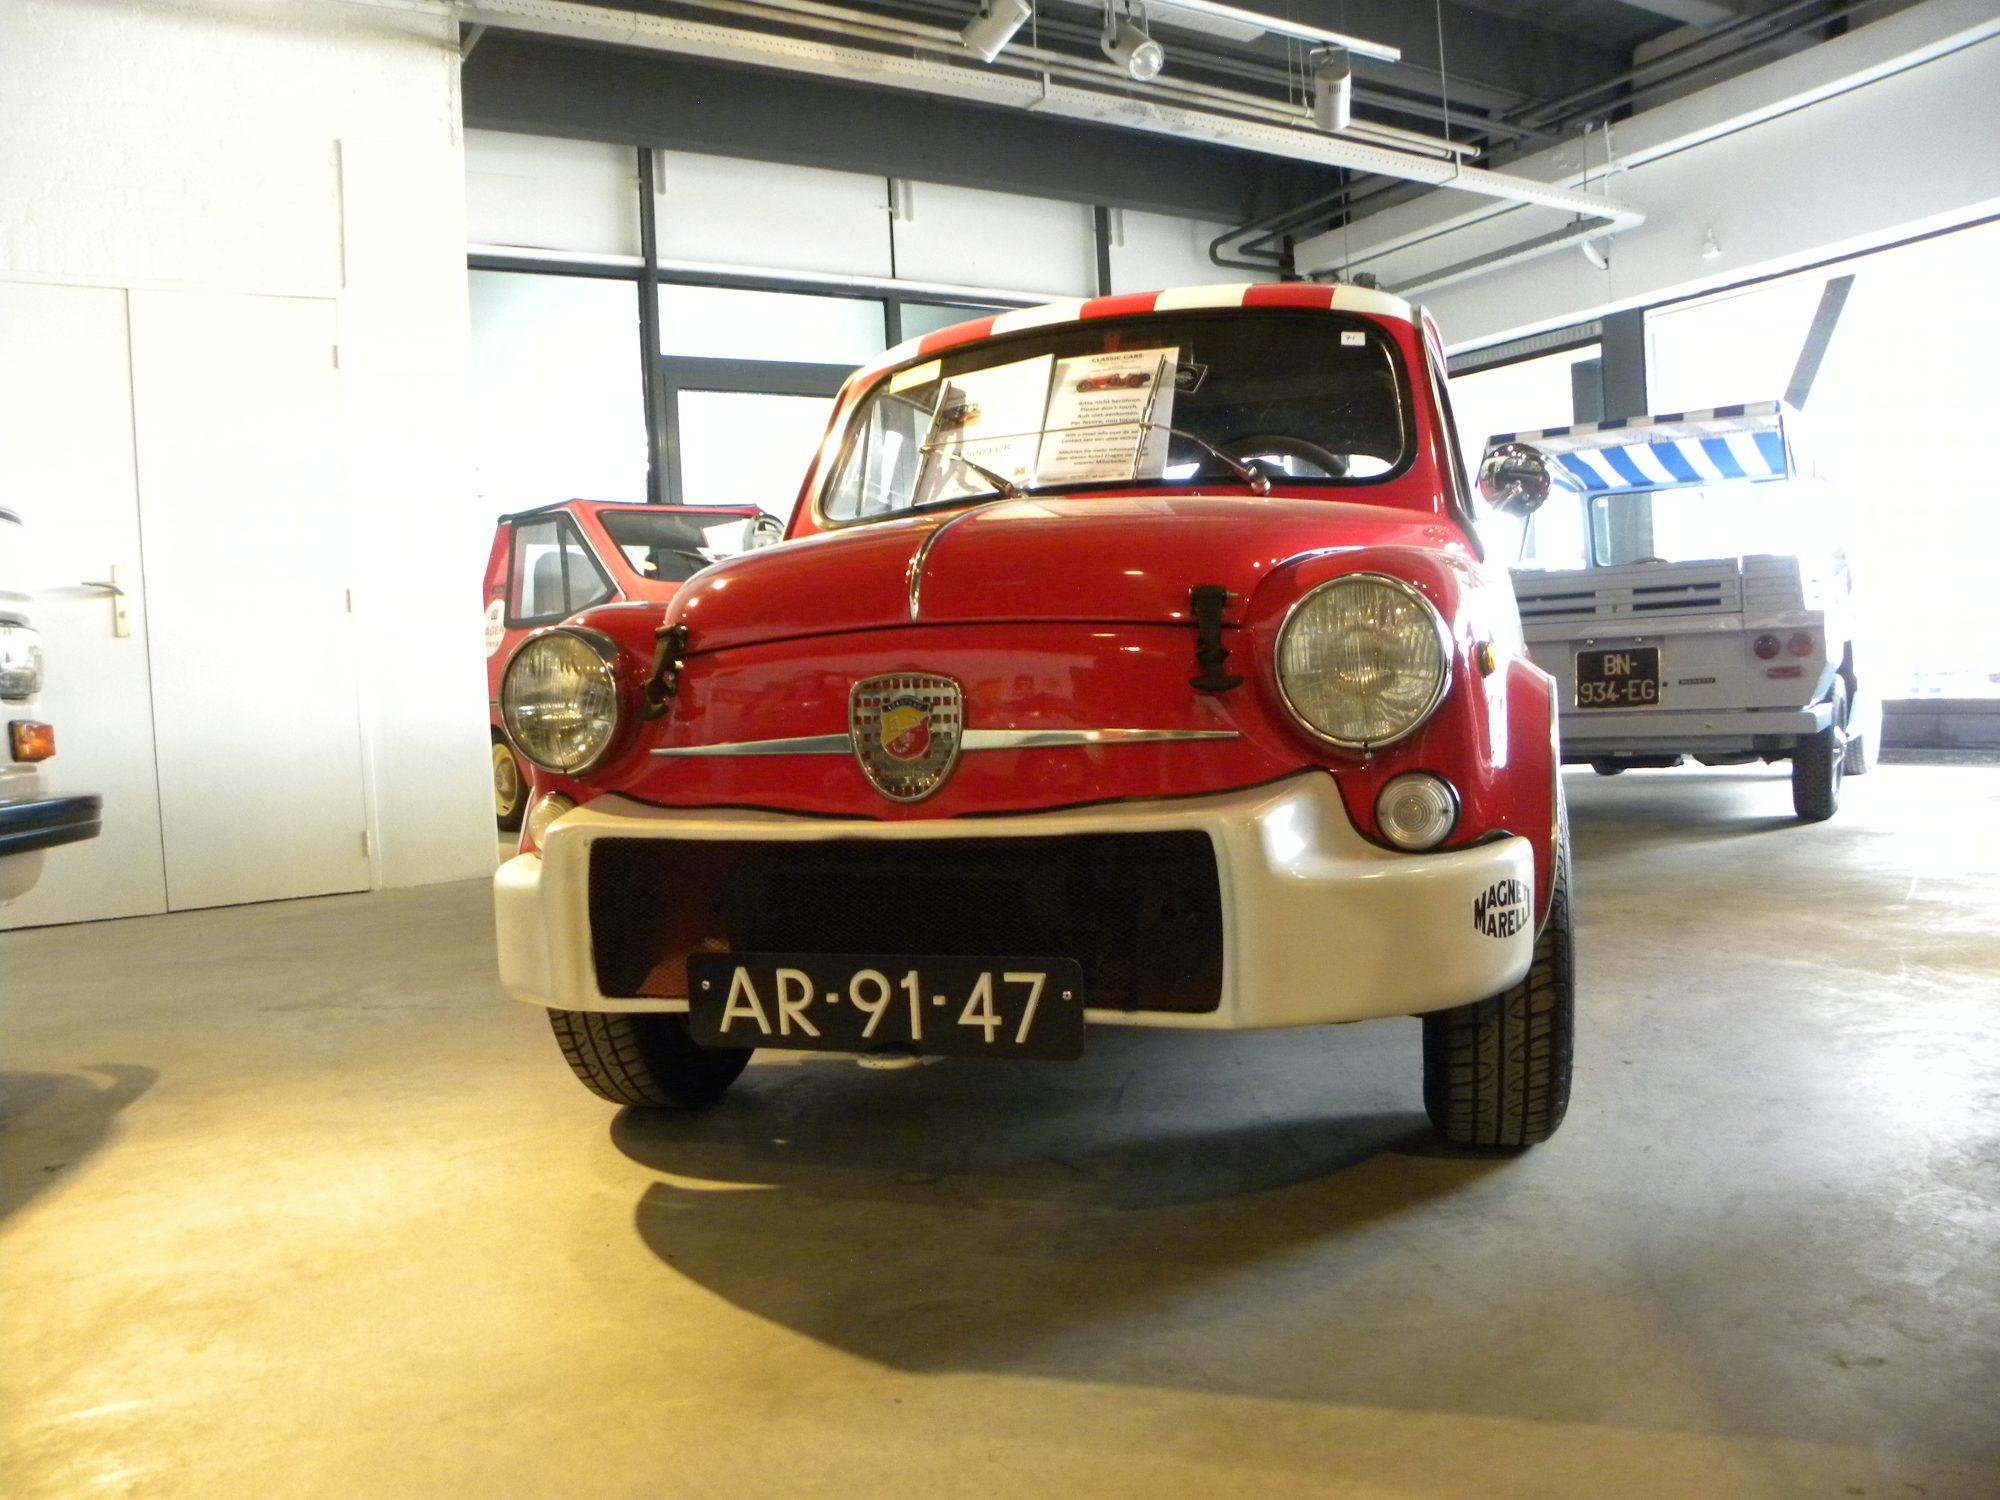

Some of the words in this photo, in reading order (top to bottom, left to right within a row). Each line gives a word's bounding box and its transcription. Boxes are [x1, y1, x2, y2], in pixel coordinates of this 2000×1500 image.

[1092, 355, 1121, 363] CLASSIC
[1580, 679, 1656, 703] 934-EG
[720, 966, 1047, 1043] AR-91-47
